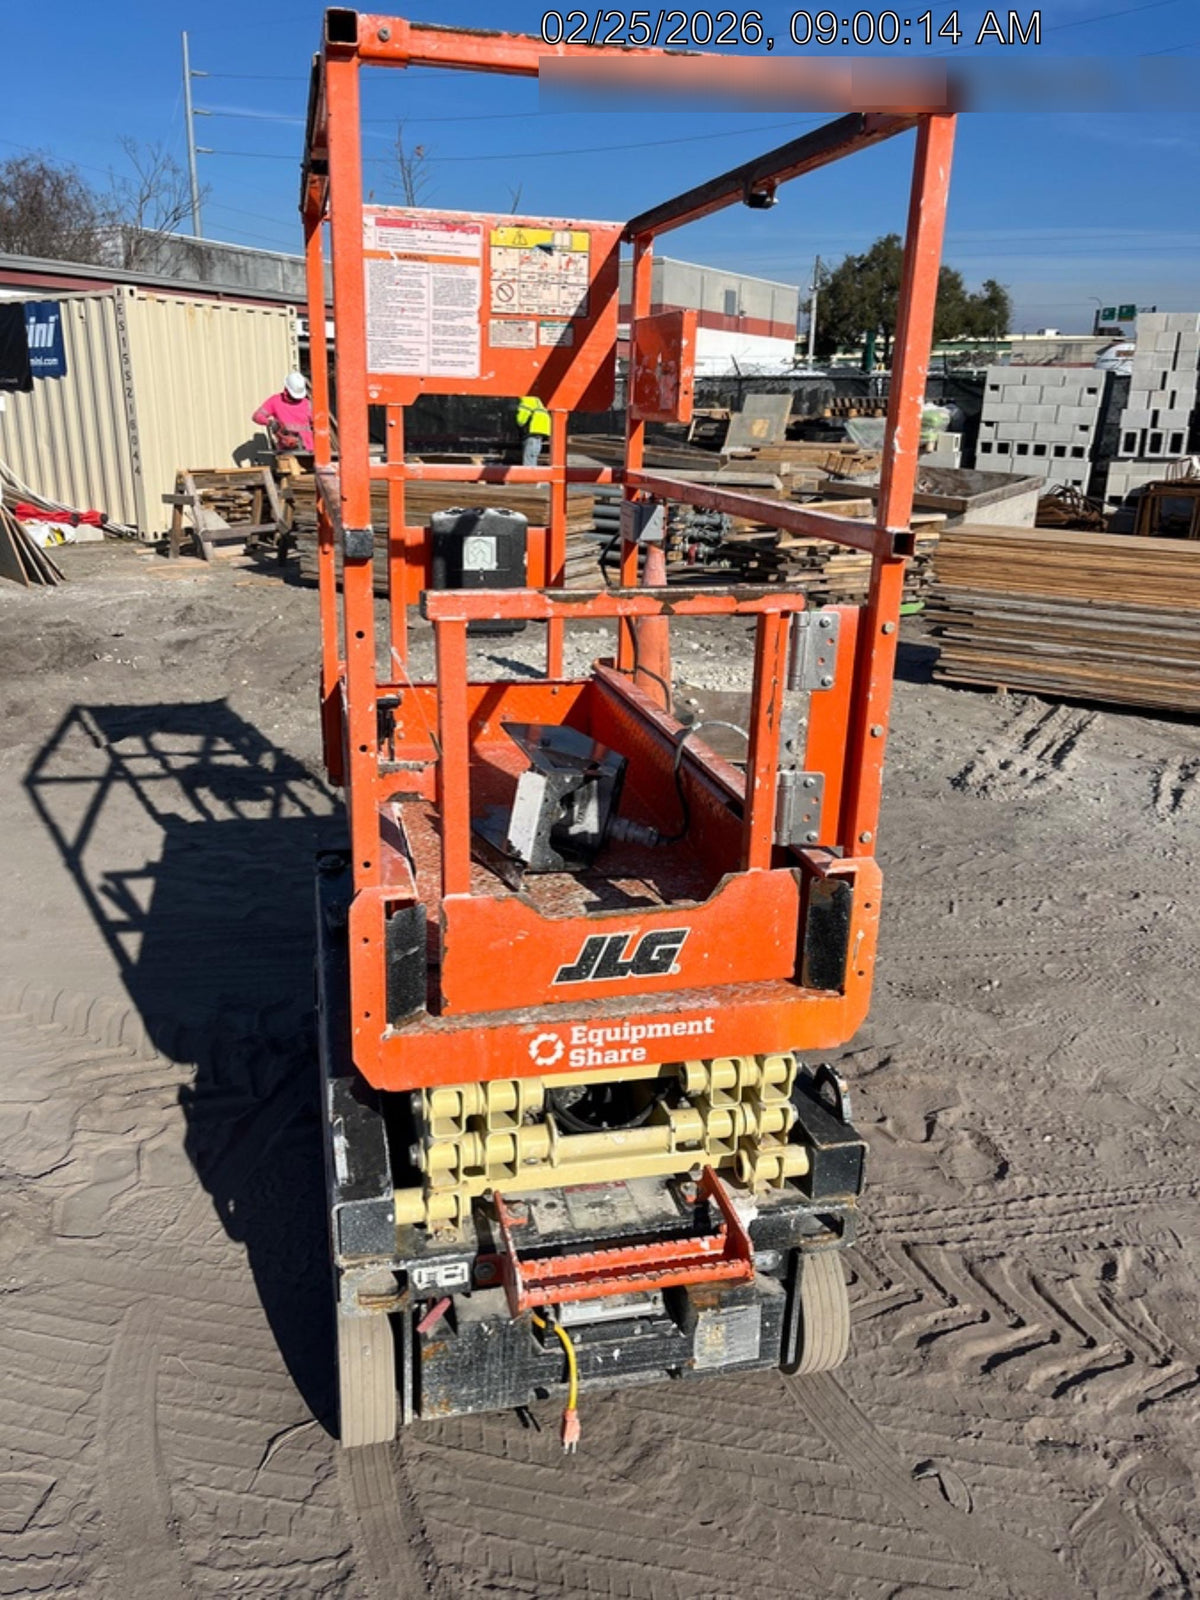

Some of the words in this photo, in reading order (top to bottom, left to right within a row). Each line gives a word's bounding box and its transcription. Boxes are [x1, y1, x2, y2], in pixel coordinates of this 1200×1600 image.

[25, 315, 56, 348] ini
[551, 927, 692, 986] JLG
[570, 1016, 715, 1046] Equipment
[568, 1046, 647, 1067] Share
